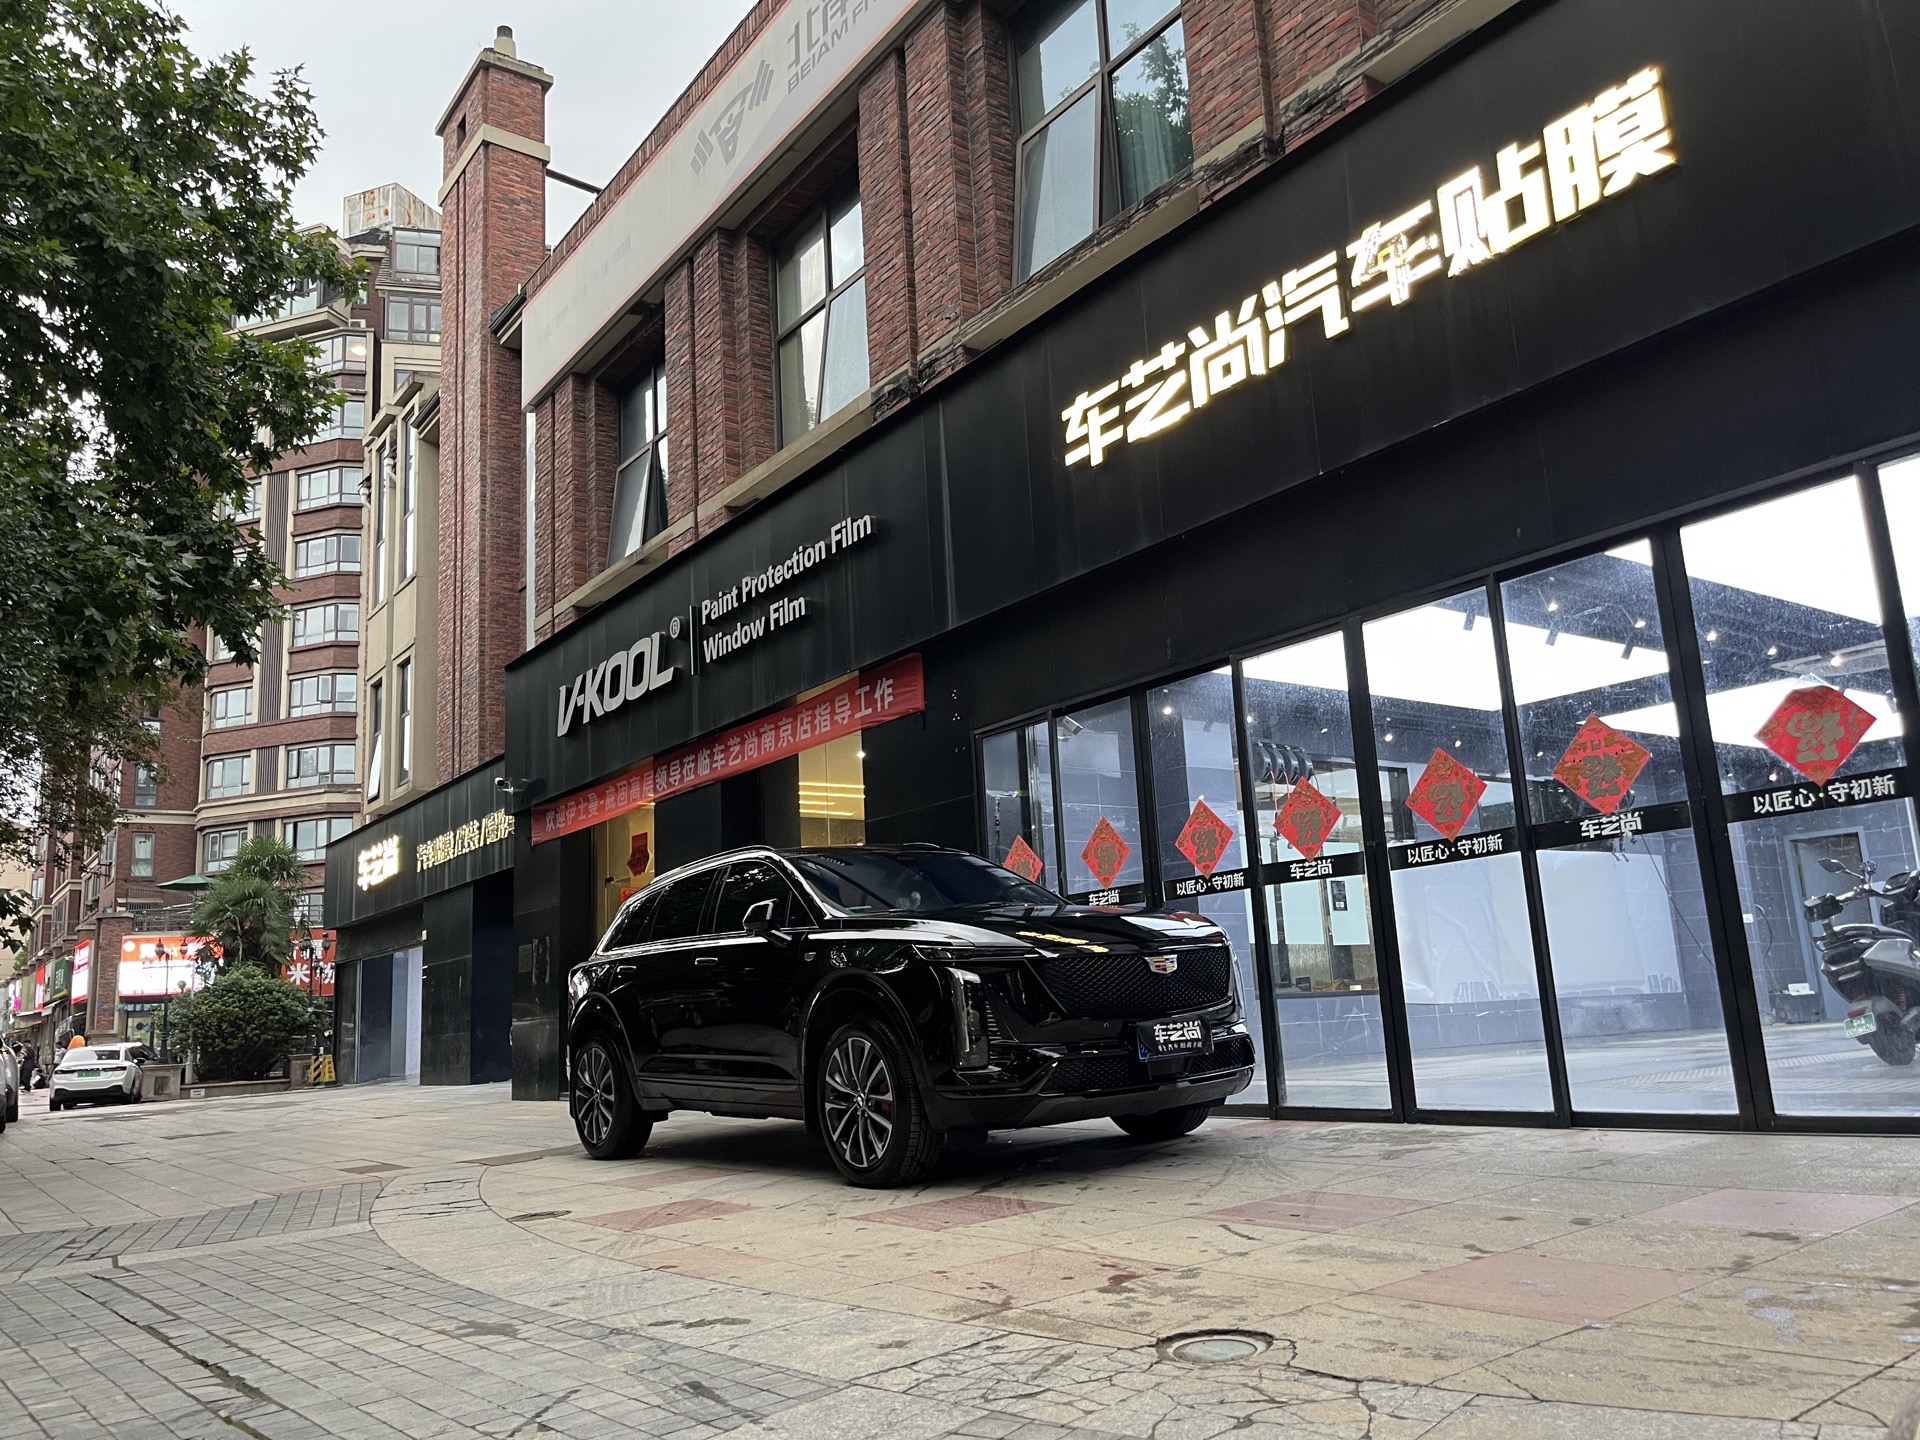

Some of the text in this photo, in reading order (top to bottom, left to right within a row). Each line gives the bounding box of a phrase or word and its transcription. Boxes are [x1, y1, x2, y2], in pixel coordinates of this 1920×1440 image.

[788, 17, 848, 94] BEIAM
[1063, 67, 1677, 466] 车艺尚汽车贴膜
[702, 515, 872, 625] Paint Protection Film
[704, 596, 806, 663] Window Film
[1753, 774, 1896, 814] 以匠心·守初新
[1579, 811, 1642, 839] 车艺尚
[358, 834, 400, 891] 车艺尚
[1407, 834, 1503, 864] 以匠心·守初新
[1176, 872, 1244, 895] 以匠心·守初新
[1290, 859, 1333, 879] 车艺尚
[1088, 889, 1120, 906] 车艺尚
[1153, 1020, 1202, 1043] 车艺尚
